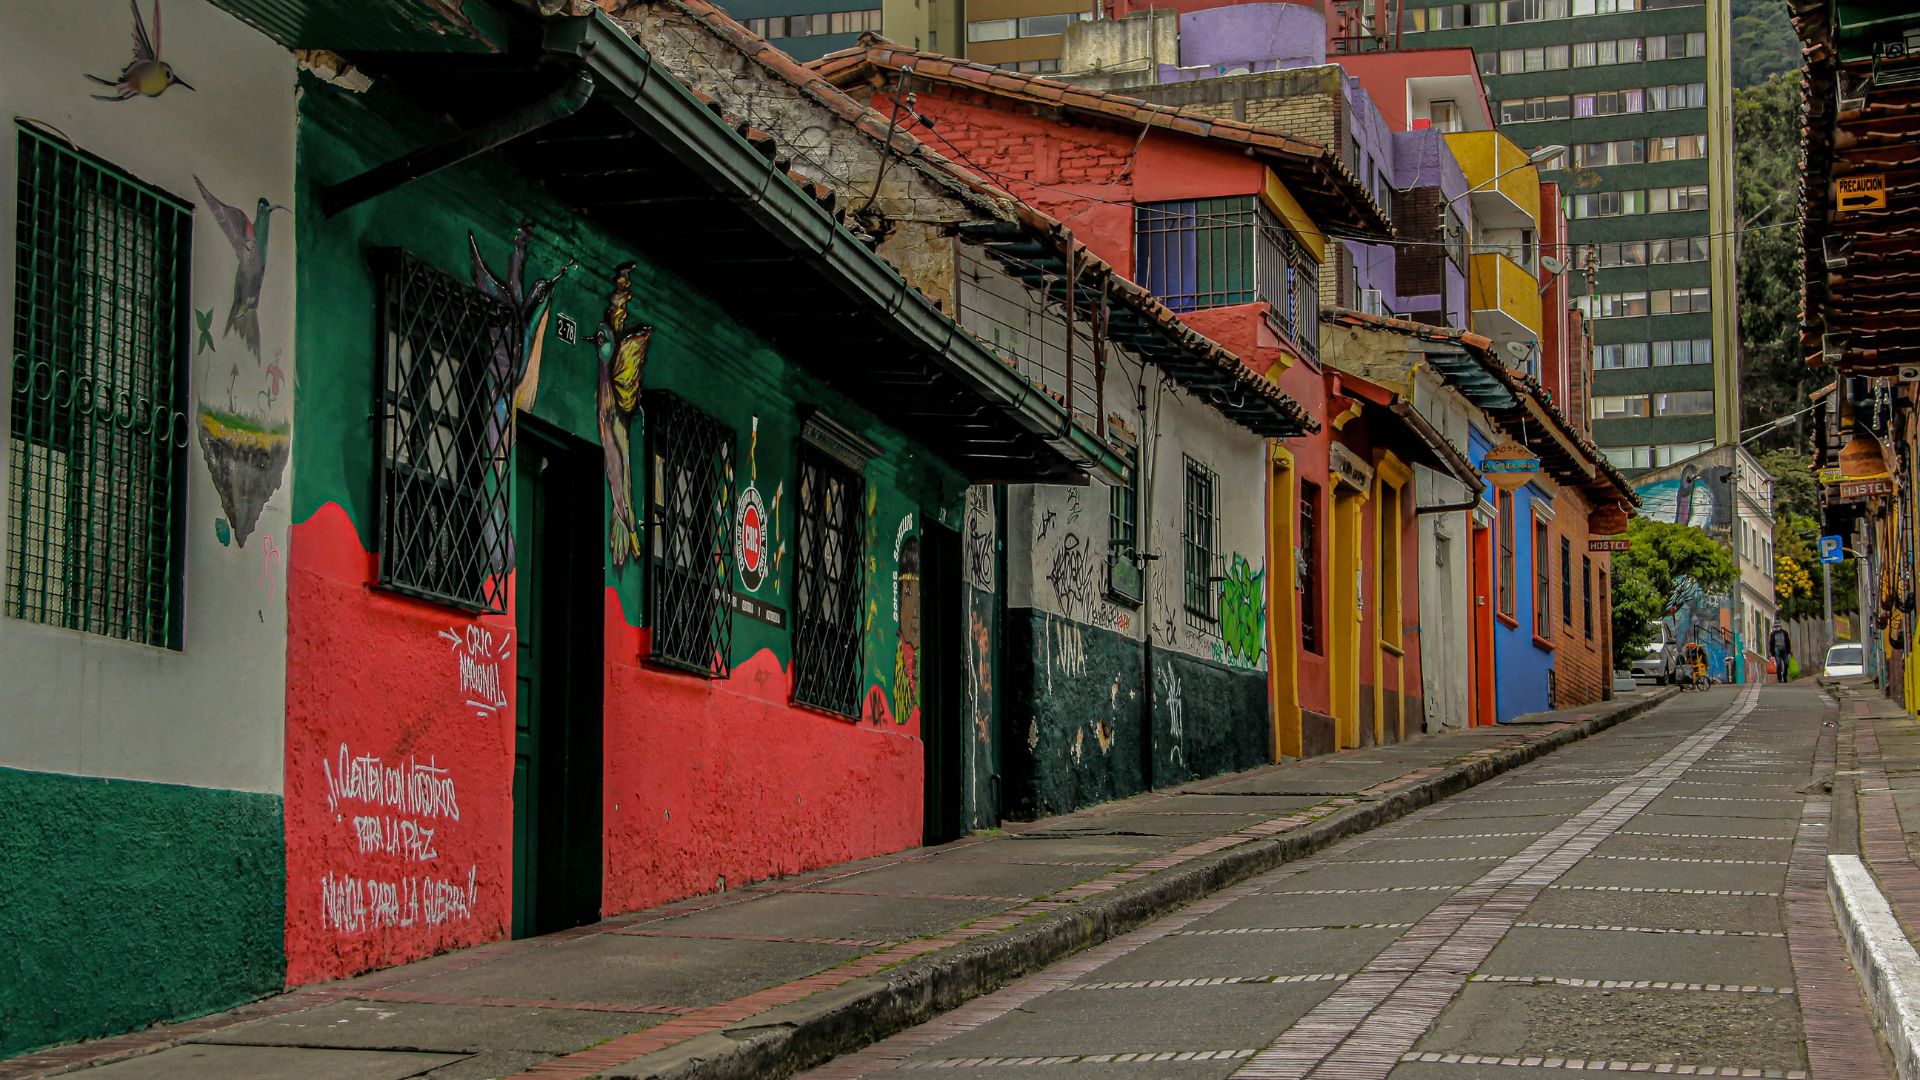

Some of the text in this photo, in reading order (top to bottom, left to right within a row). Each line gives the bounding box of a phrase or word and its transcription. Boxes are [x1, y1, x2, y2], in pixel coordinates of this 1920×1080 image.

[1843, 483, 1891, 495] HOSTEL
[1590, 541, 1629, 550] HOSTEL
[1821, 539, 1837, 557] P
[467, 624, 492, 660] CRIC
[354, 815, 437, 862] PARA LA PAZ
[367, 879, 399, 929] PARA
[401, 876, 419, 927] LA
